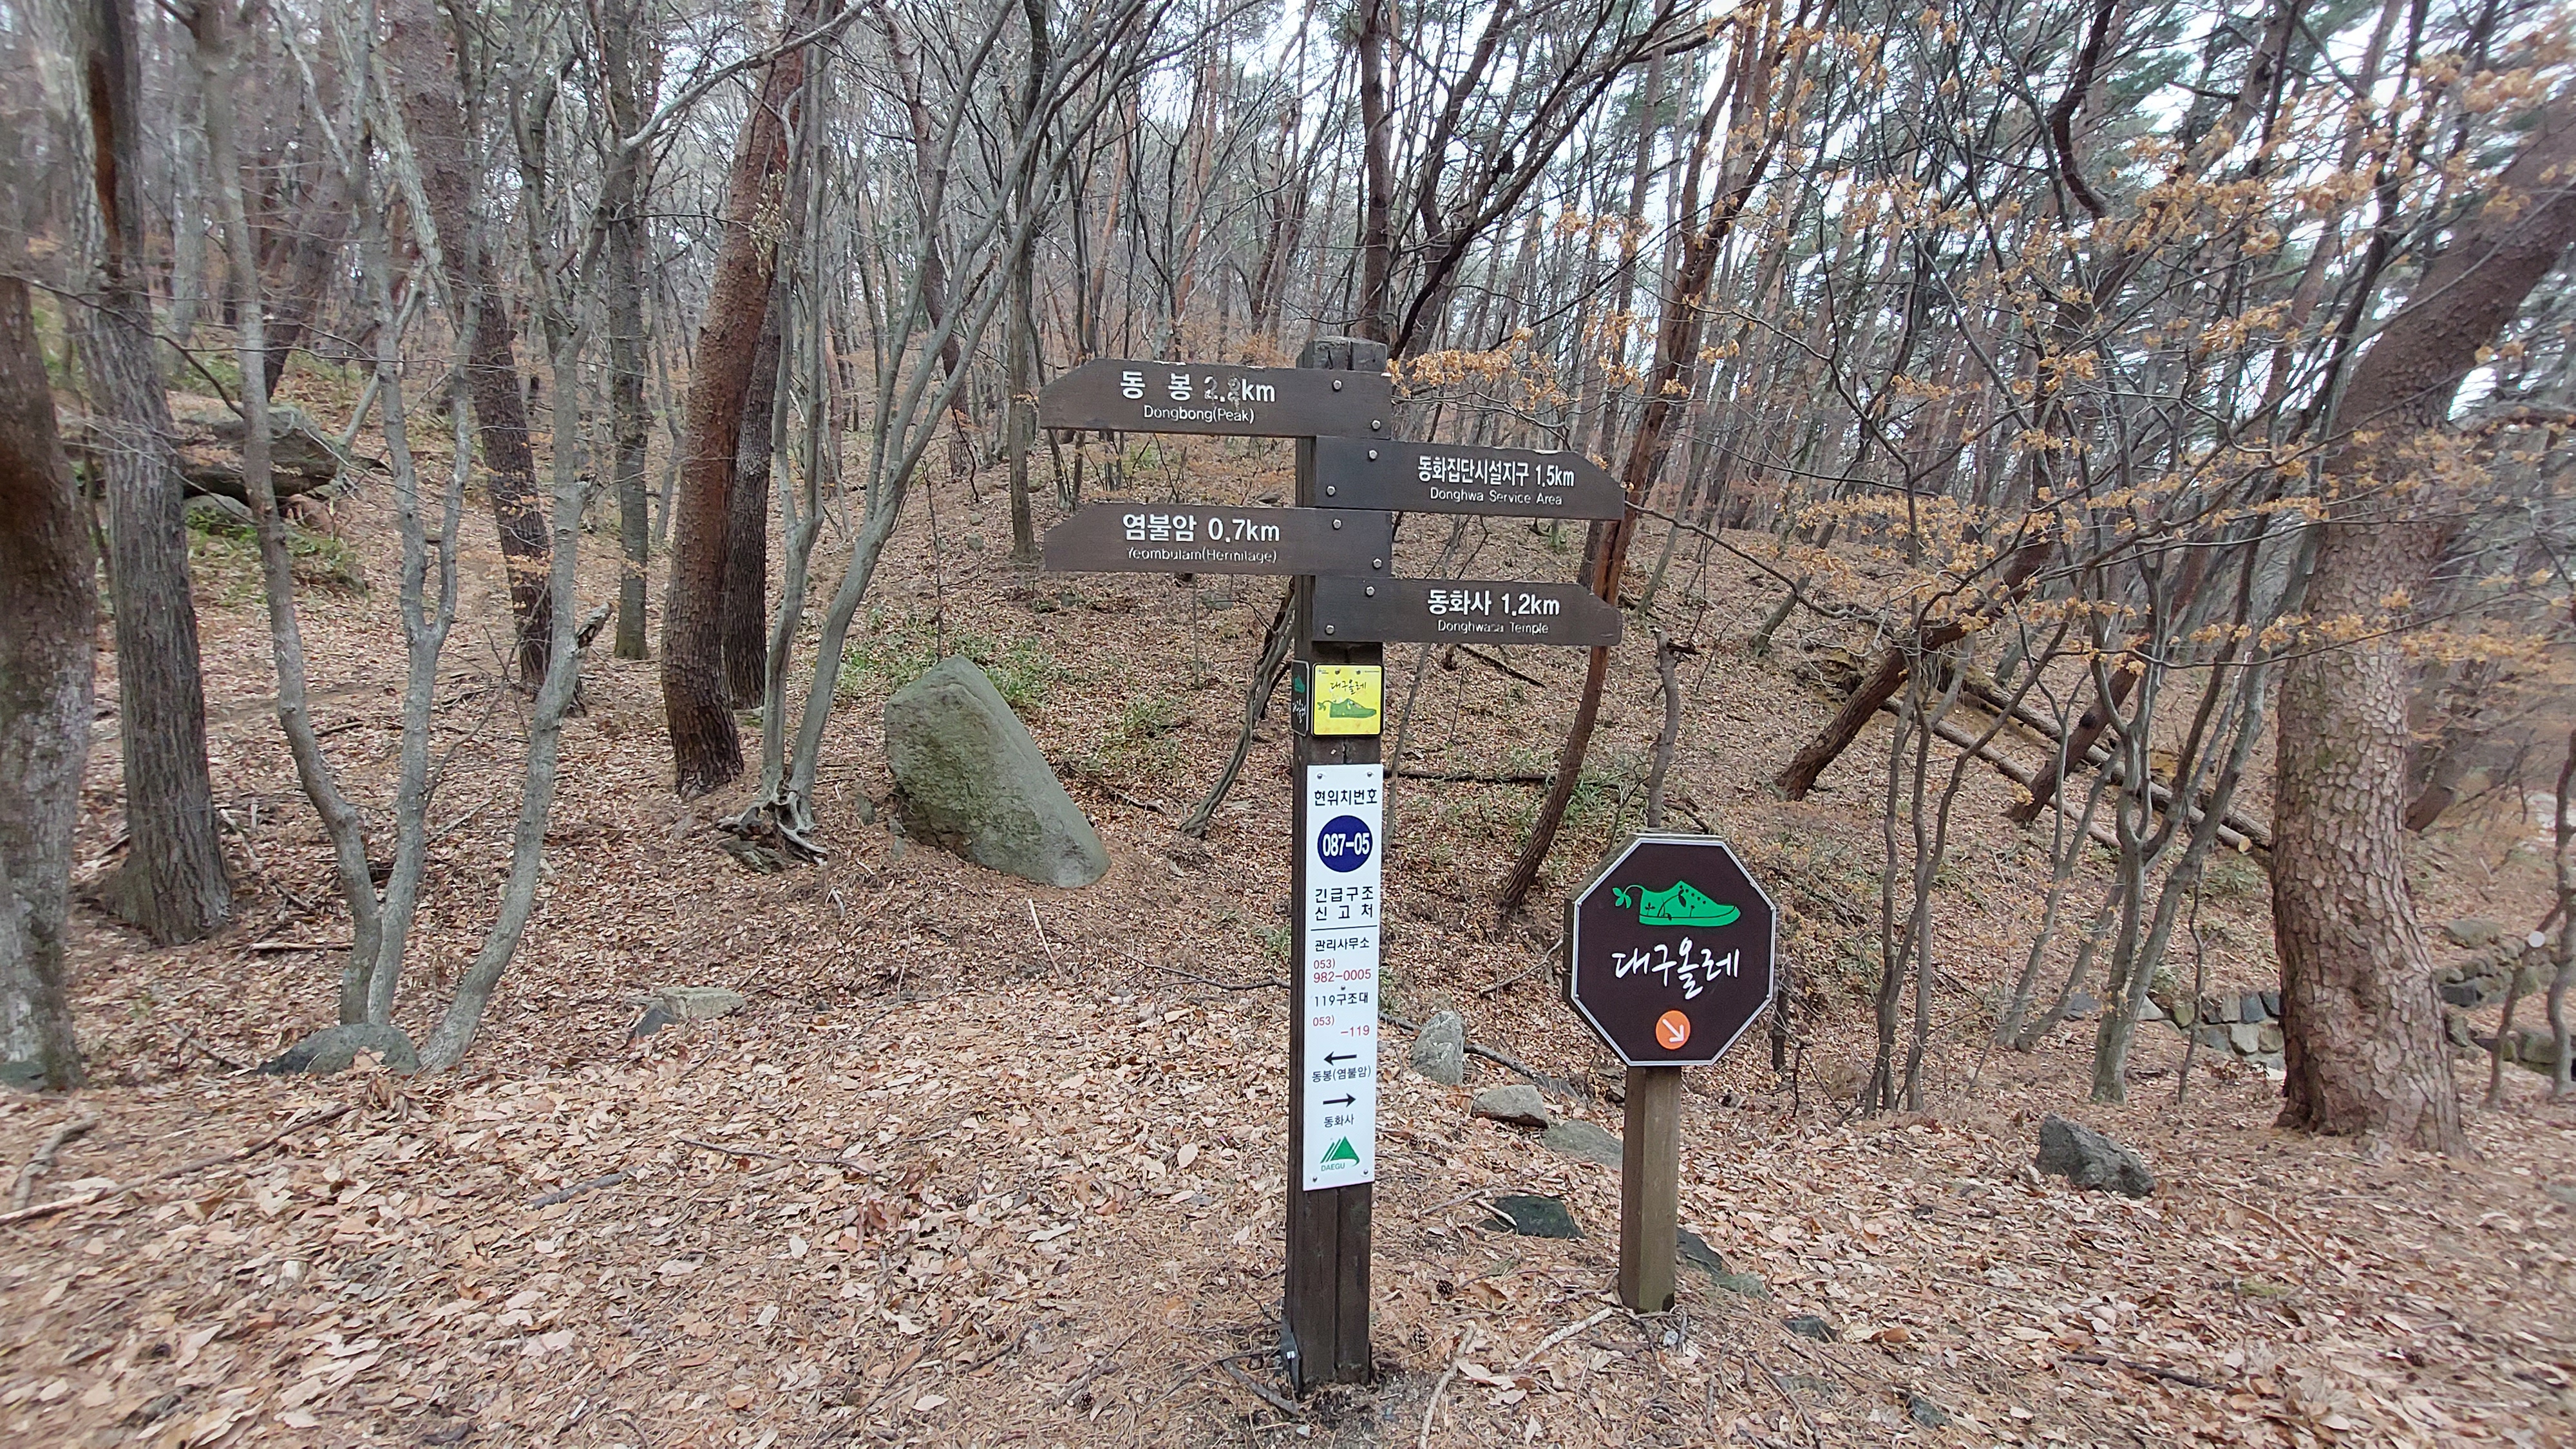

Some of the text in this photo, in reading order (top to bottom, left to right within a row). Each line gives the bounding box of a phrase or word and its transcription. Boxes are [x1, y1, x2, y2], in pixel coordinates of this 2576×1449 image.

[1143, 404, 1255, 424] Dongbong(Peak)
[1417, 455, 1575, 488] 동화집단시설지구 1.5km
[1430, 486, 1563, 506] Donghwa Service Area
[1122, 513, 1280, 543] 염불암 0.7km
[1427, 589, 1560, 616] 동화사 1.2km
[1509, 621, 1549, 636] Temple
[1330, 679, 1367, 696] 대구올레
[1314, 788, 1378, 806] 현위치번호
[1322, 832, 1370, 857] 087-05
[1315, 886, 1374, 904] 긴급구조
[1314, 936, 1370, 952] 관리사무소
[1313, 957, 1336, 970] 053)
[1611, 936, 1740, 999] 대구올레
[1313, 968, 1371, 983] 982-0005
[1314, 992, 1368, 1007] 119구조대
[1312, 1015, 1334, 1027] 053)
[1340, 1025, 1370, 1037] -119
[1311, 1065, 1371, 1083] 동봉(염불암)
[1323, 1113, 1354, 1128] 동화사
[1320, 1162, 1345, 1172] DAEGU
